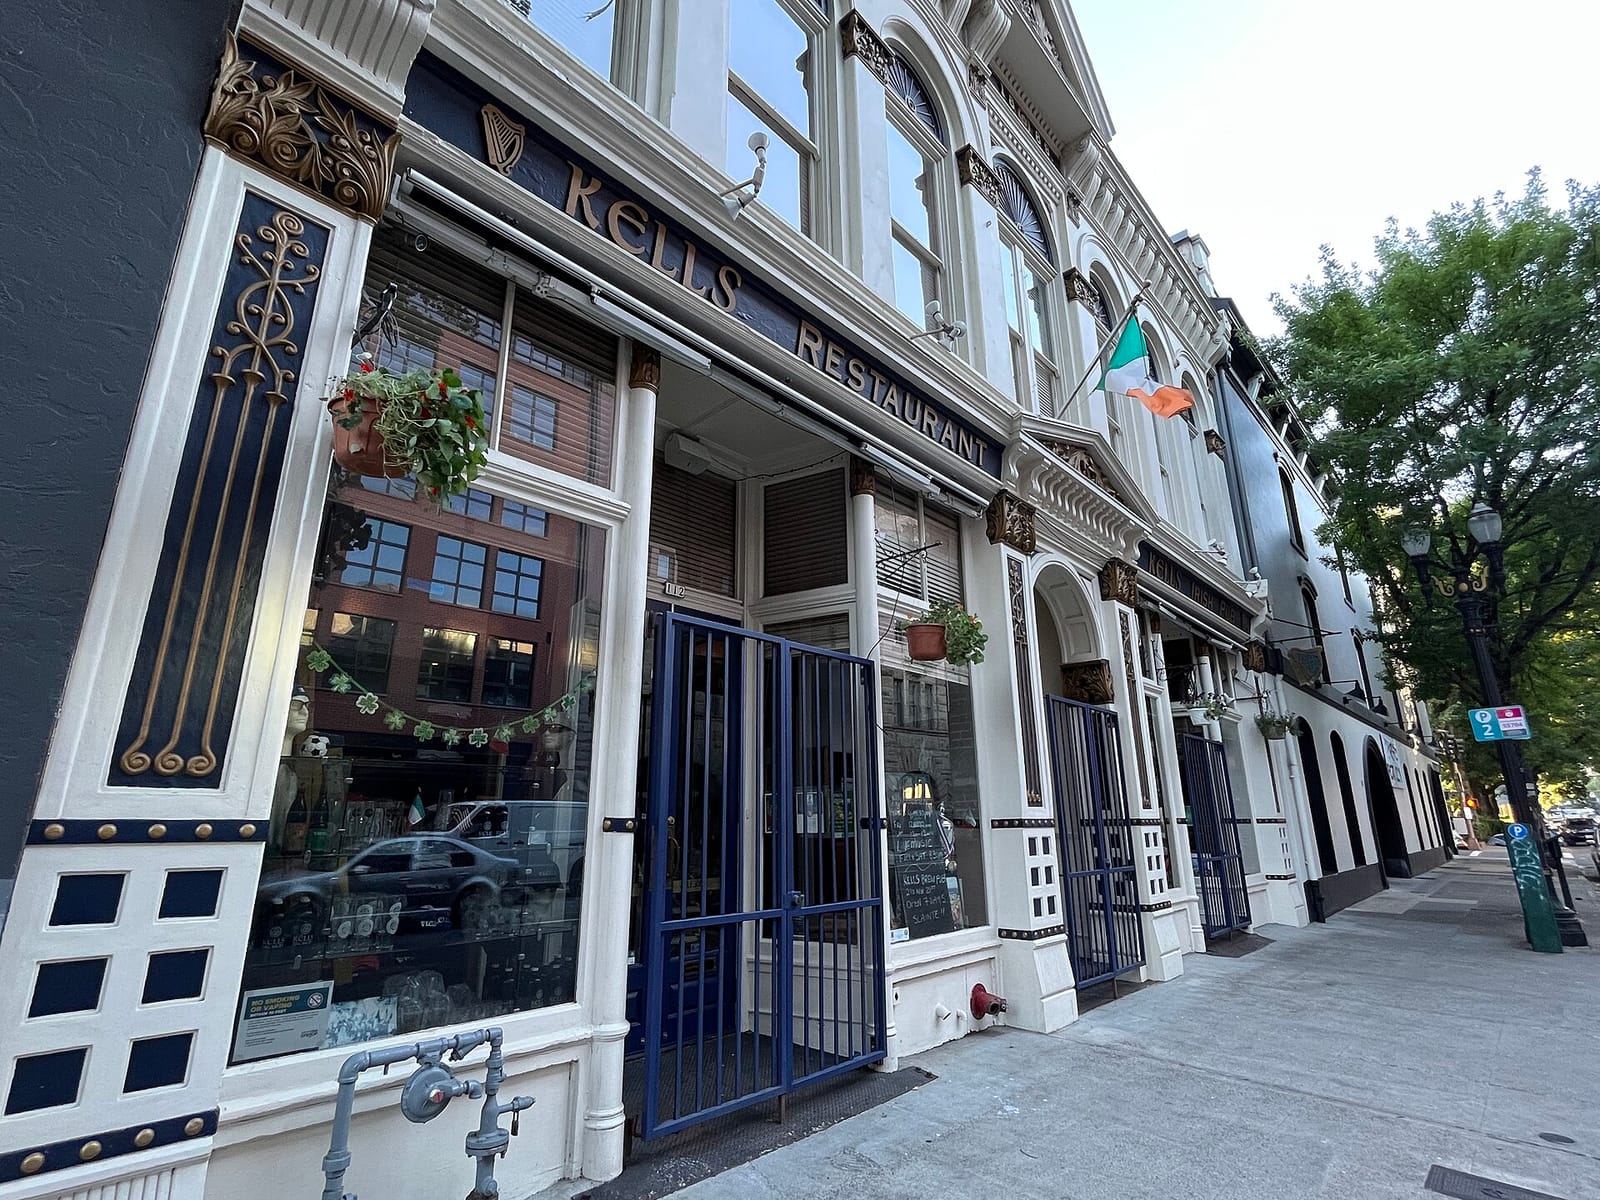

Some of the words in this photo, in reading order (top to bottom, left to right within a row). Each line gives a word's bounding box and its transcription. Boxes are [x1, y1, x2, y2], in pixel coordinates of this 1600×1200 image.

[564, 160, 743, 313] KELLS
[796, 320, 988, 467] RESTAURANT
[1148, 551, 1182, 591] KELLS
[1191, 582, 1213, 609] IRISH
[667, 584, 684, 596] 112
[1481, 724, 1494, 736] 2
[1514, 826, 1523, 837] P
[265, 994, 301, 1005] SMOKING
